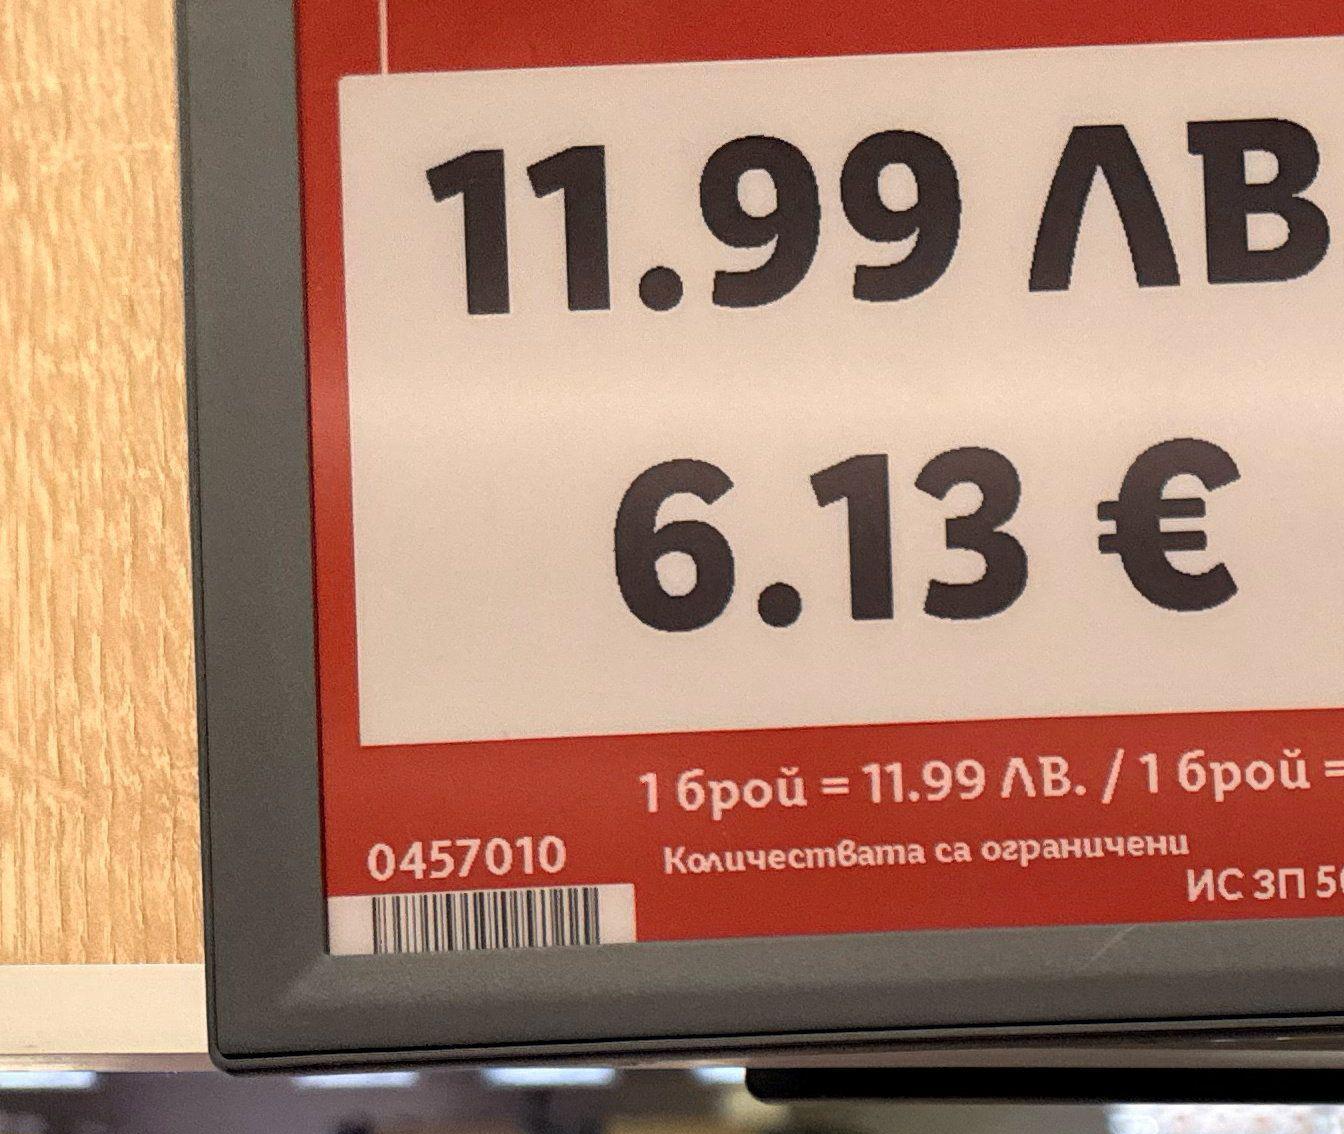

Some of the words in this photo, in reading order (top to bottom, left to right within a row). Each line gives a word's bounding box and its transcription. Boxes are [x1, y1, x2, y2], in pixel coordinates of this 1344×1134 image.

[425, 129, 963, 316] 11.99
[612, 446, 1029, 633] 6.13
[1096, 437, 1241, 613] €
[639, 772, 658, 813] 1
[676, 766, 808, 821] брой
[821, 777, 851, 794] =
[861, 759, 986, 804] 11.99
[1000, 755, 1087, 798] ЛВ.
[1101, 748, 1125, 804] /
[1139, 752, 1159, 794] 1
[1177, 748, 1311, 803] брой
[367, 835, 567, 882] 0457010
[663, 839, 927, 875] Количествата
[934, 841, 973, 863] са
[980, 834, 1190, 867] ограничени
[1186, 867, 1245, 902] ИС
